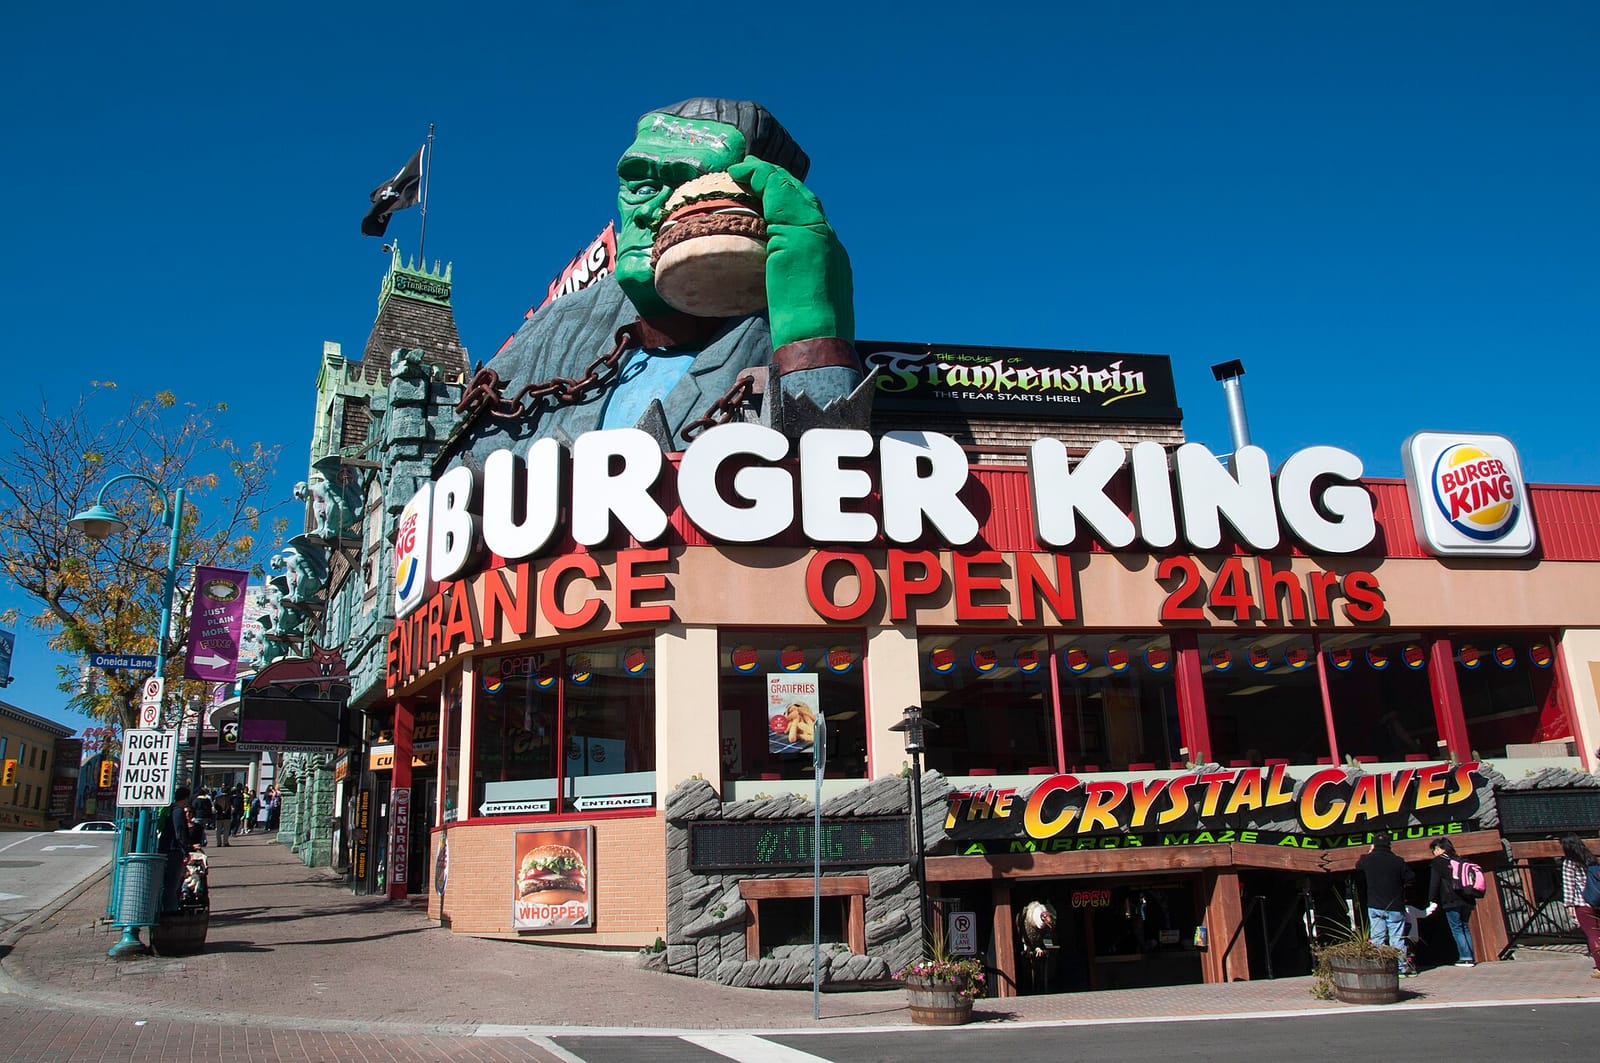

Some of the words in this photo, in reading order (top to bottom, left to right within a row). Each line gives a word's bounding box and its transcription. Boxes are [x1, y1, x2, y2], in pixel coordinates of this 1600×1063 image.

[933, 353, 955, 361] THE
[957, 353, 993, 363] HOUSE
[1007, 356, 1024, 364] OF
[865, 351, 1147, 406] Frankenstein
[934, 391, 960, 399] THE
[962, 391, 994, 400] FEAR
[998, 393, 1043, 402] STARTS
[1441, 459, 1507, 494] BURGER
[431, 422, 980, 582] BURGER
[1029, 437, 1377, 554] KING
[1449, 475, 1514, 520] KING
[806, 549, 1077, 621] OPEN
[1156, 554, 1386, 623] 24hrs
[203, 607, 226, 617] JUST
[386, 547, 671, 690] ENTRANCE
[207, 615, 234, 626] PLAIN
[202, 626, 230, 638] MORE
[96, 656, 128, 667] Oneida
[130, 658, 153, 668] Lane
[501, 656, 542, 675] OPEN
[771, 683, 815, 694] GRATIFRIES
[129, 735, 173, 749] RIGHT
[238, 744, 279, 752] CURRENCY
[281, 745, 323, 753] EXCHANGE
[128, 752, 168, 766] LANE
[125, 768, 169, 783] MUST
[123, 785, 166, 800] TURN
[486, 803, 547, 812] ENTRANCE
[581, 797, 649, 807] ENTRANCE
[945, 788, 1016, 829] THE
[1023, 764, 1294, 840] CRYSTAL
[1300, 762, 1481, 831] CAVES
[395, 805, 407, 882] ENTRANCE
[964, 842, 988, 855] A
[1010, 835, 1143, 854] MIRROR
[1163, 831, 1259, 846] MAZE
[1071, 890, 1111, 908] OPEN
[519, 905, 586, 920] WHOPPER
